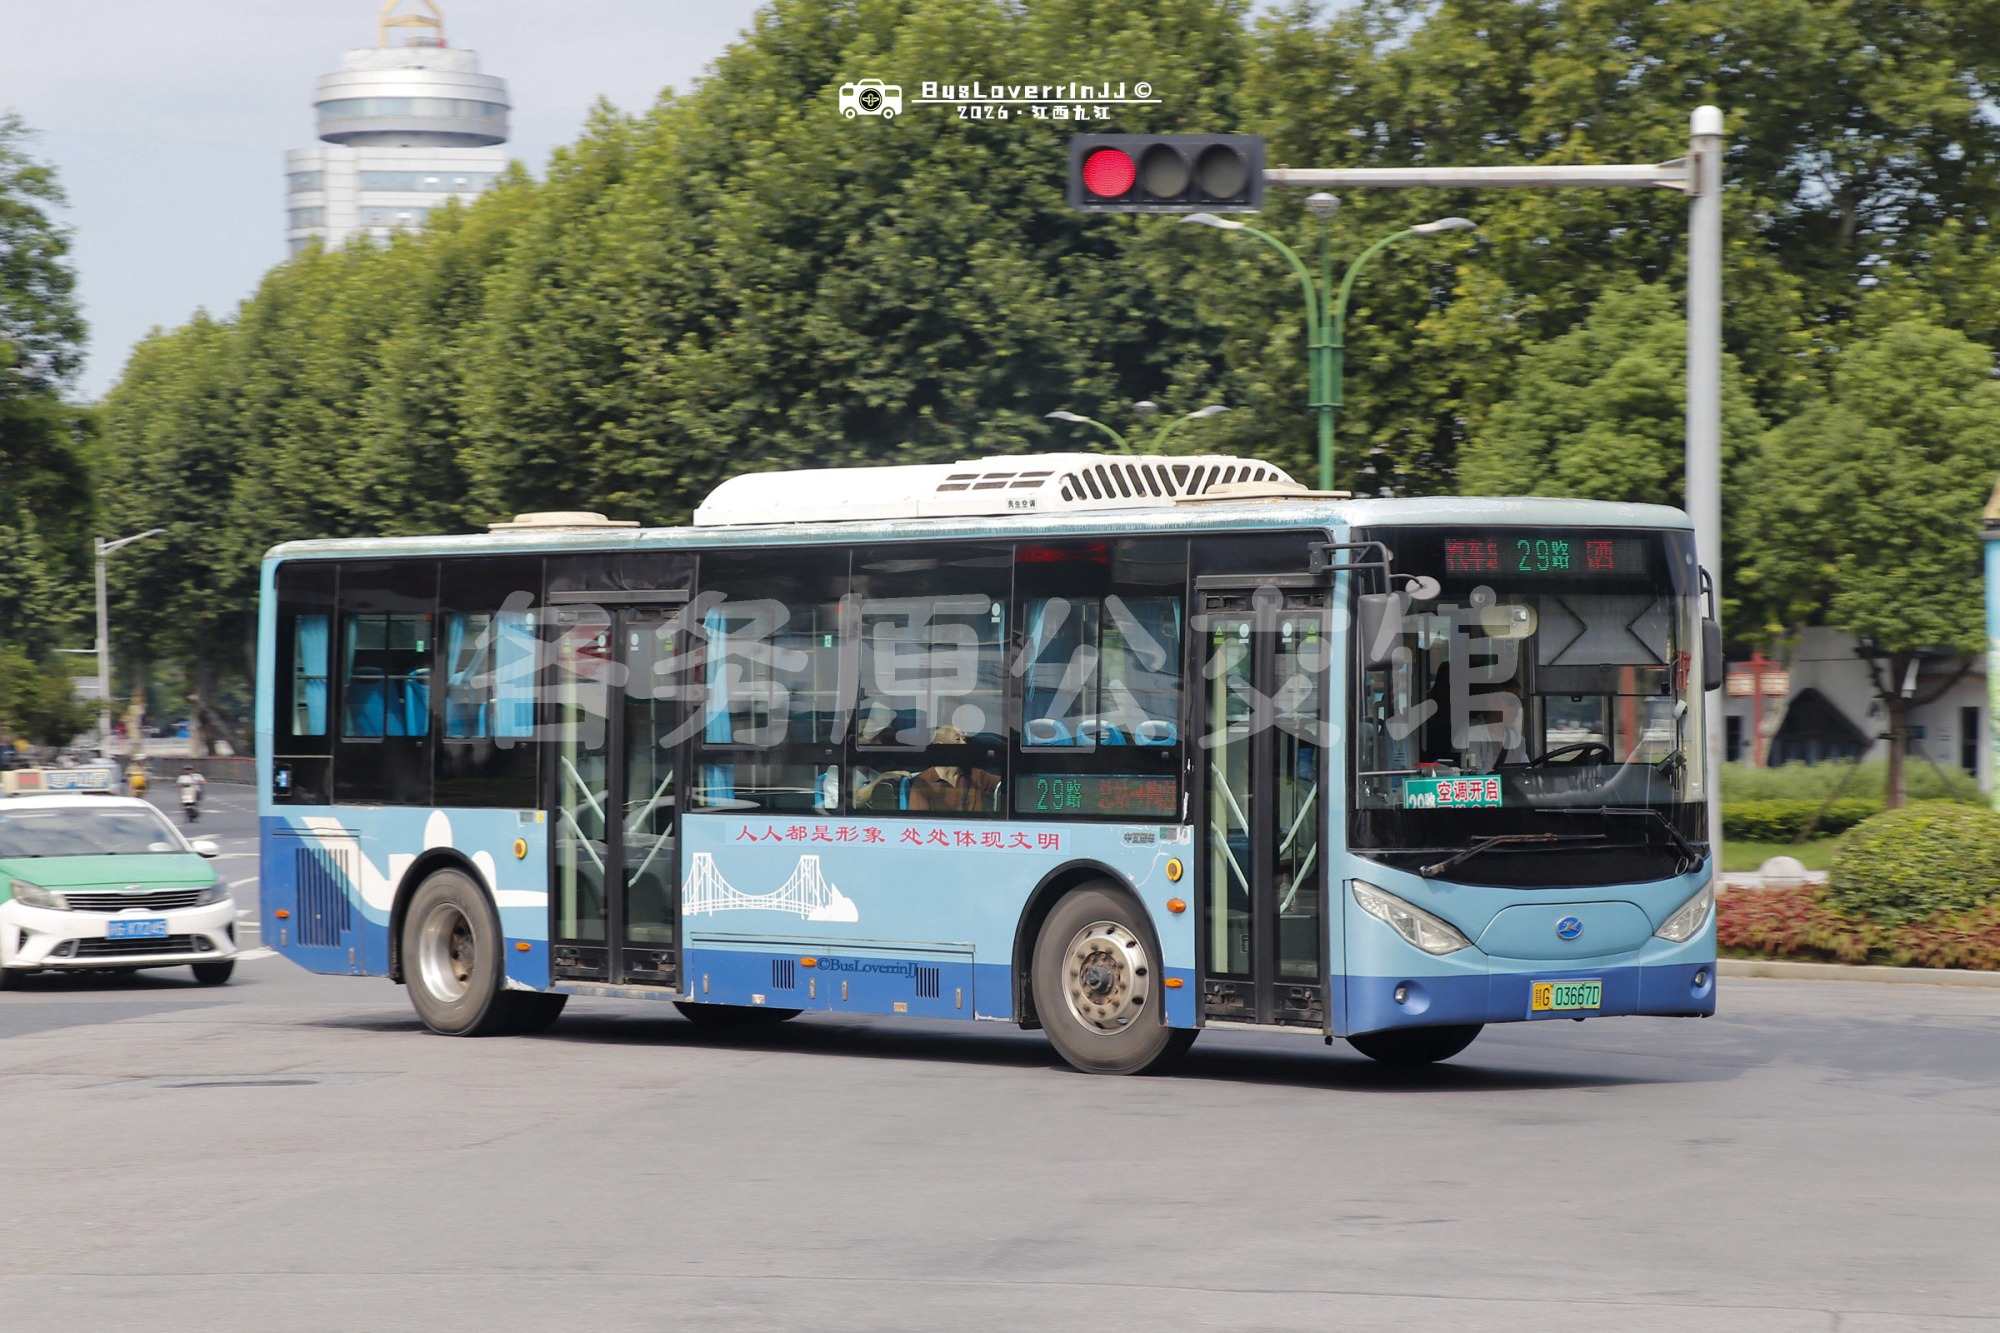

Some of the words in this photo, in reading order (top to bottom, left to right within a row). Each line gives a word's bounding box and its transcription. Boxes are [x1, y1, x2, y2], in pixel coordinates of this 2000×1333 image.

[1516, 539, 1571, 571] 29路
[1036, 778, 1083, 811] 29路
[1437, 779, 1500, 802] 空调开启
[734, 824, 886, 845] 人人都是形象
[899, 826, 1061, 851] 处处体现文明
